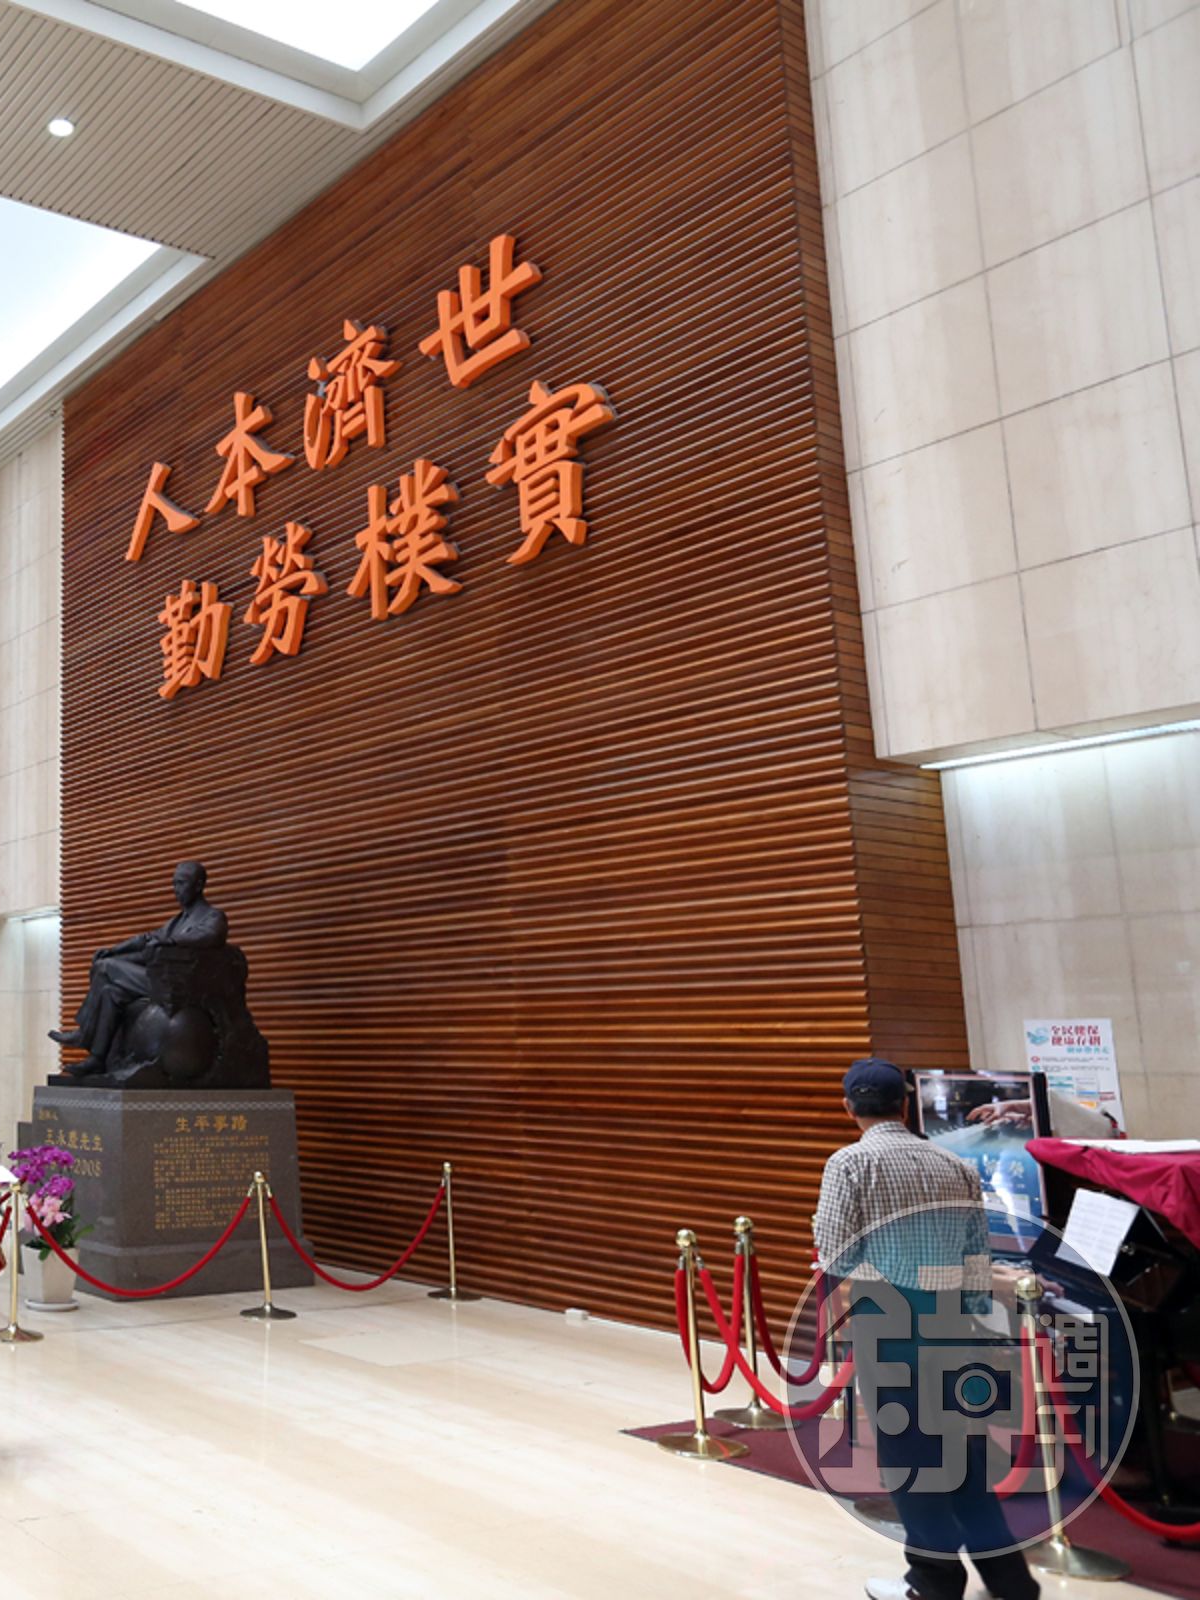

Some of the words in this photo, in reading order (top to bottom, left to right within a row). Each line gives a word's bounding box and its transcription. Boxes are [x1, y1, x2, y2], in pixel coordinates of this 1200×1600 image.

[125, 233, 543, 562] 人本濟世
[157, 379, 616, 699] 勤勞樸實
